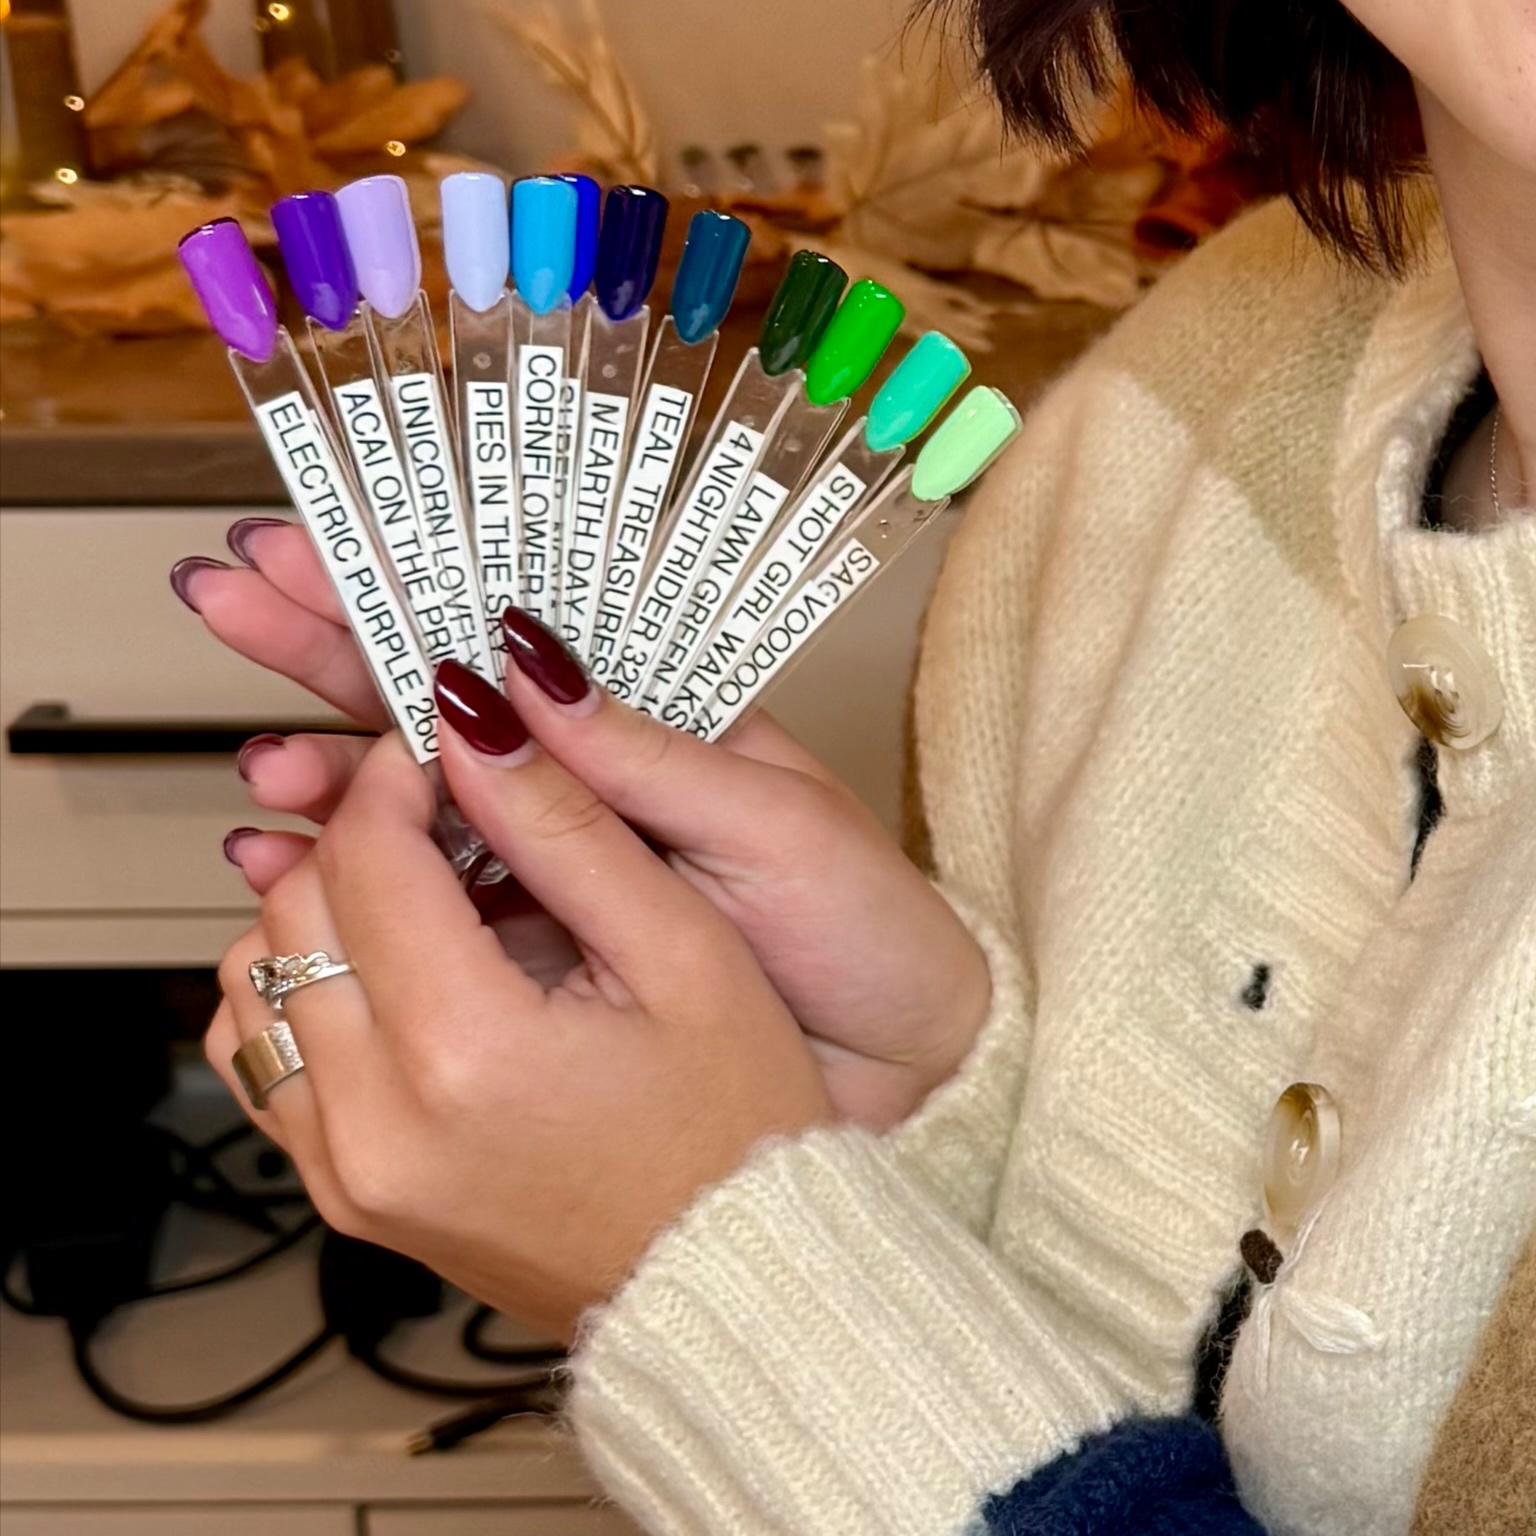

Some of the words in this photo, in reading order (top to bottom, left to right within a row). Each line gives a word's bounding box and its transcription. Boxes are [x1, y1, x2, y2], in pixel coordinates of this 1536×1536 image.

[341, 393, 393, 467] ACAI
[398, 380, 456, 538] UNICORN
[474, 388, 506, 463] PIES
[639, 395, 688, 469] TEAL
[372, 475, 412, 526] ON
[478, 475, 509, 505] IN
[268, 401, 362, 563] ELECTRIC
[345, 566, 425, 696] PURPLE
[391, 530, 436, 599] THE
[480, 516, 512, 583] THE
[629, 452, 745, 642] NIGHTRIDER
[709, 484, 777, 576] LAWN
[563, 548, 596, 616] DAY
[589, 484, 663, 676] TREASURES
[732, 561, 792, 622] GIRL
[414, 605, 458, 667] PRI
[652, 578, 722, 685] GREEN
[715, 594, 828, 707] VOODOO
[661, 630, 745, 729] WALKS
